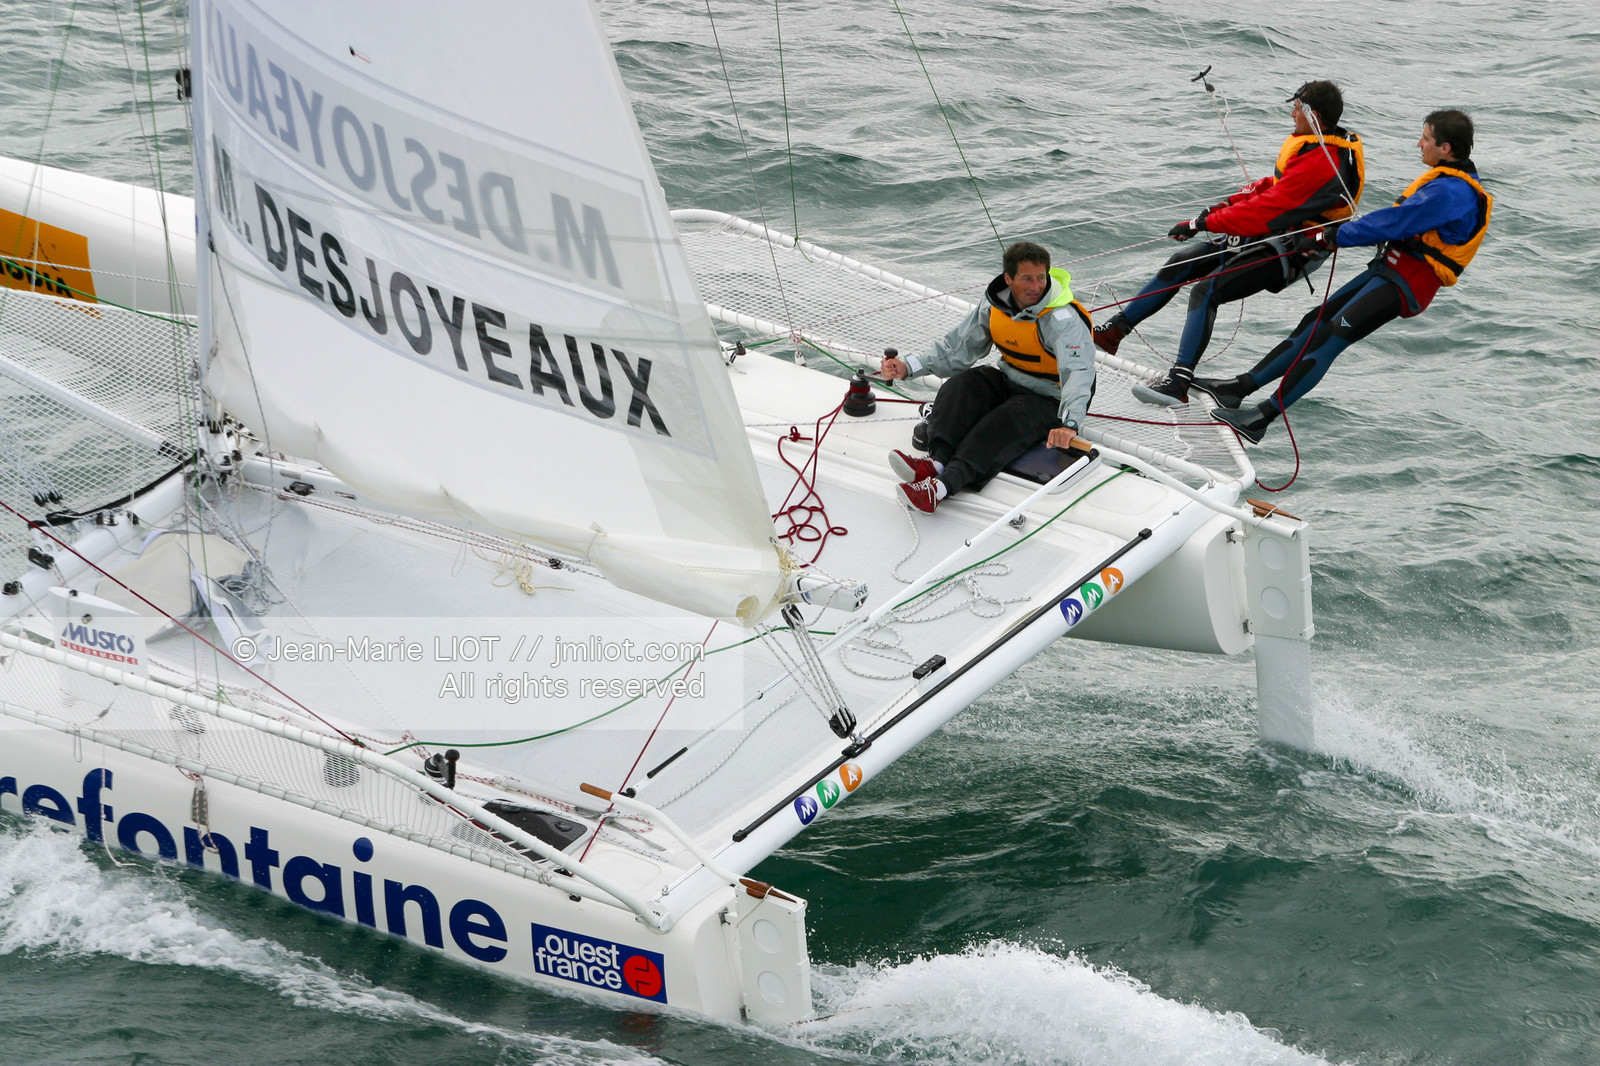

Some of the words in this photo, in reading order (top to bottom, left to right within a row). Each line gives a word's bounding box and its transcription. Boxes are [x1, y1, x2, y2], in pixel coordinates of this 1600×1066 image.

[254, 182, 671, 437] DESJOYEAUX
[60, 638, 138, 665] PERFORMANCE
[61, 622, 135, 655] MUSTO
[535, 946, 622, 990] france
[545, 934, 621, 970] ouest
